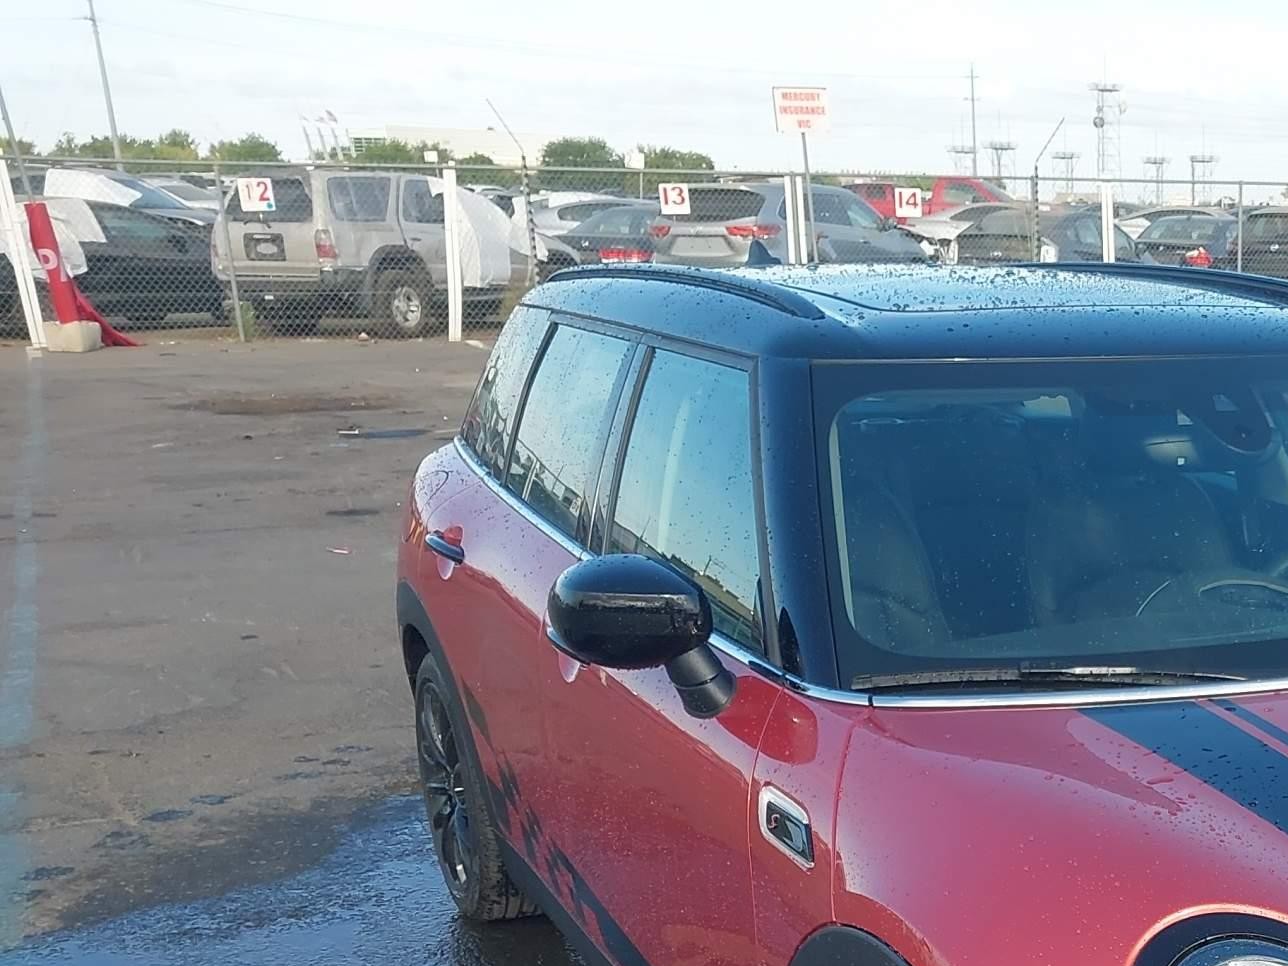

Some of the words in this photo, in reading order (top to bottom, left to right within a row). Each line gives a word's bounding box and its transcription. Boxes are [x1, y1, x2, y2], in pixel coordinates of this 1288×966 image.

[245, 181, 270, 202] 12
[662, 187, 686, 206] 13
[898, 191, 919, 209] 14
